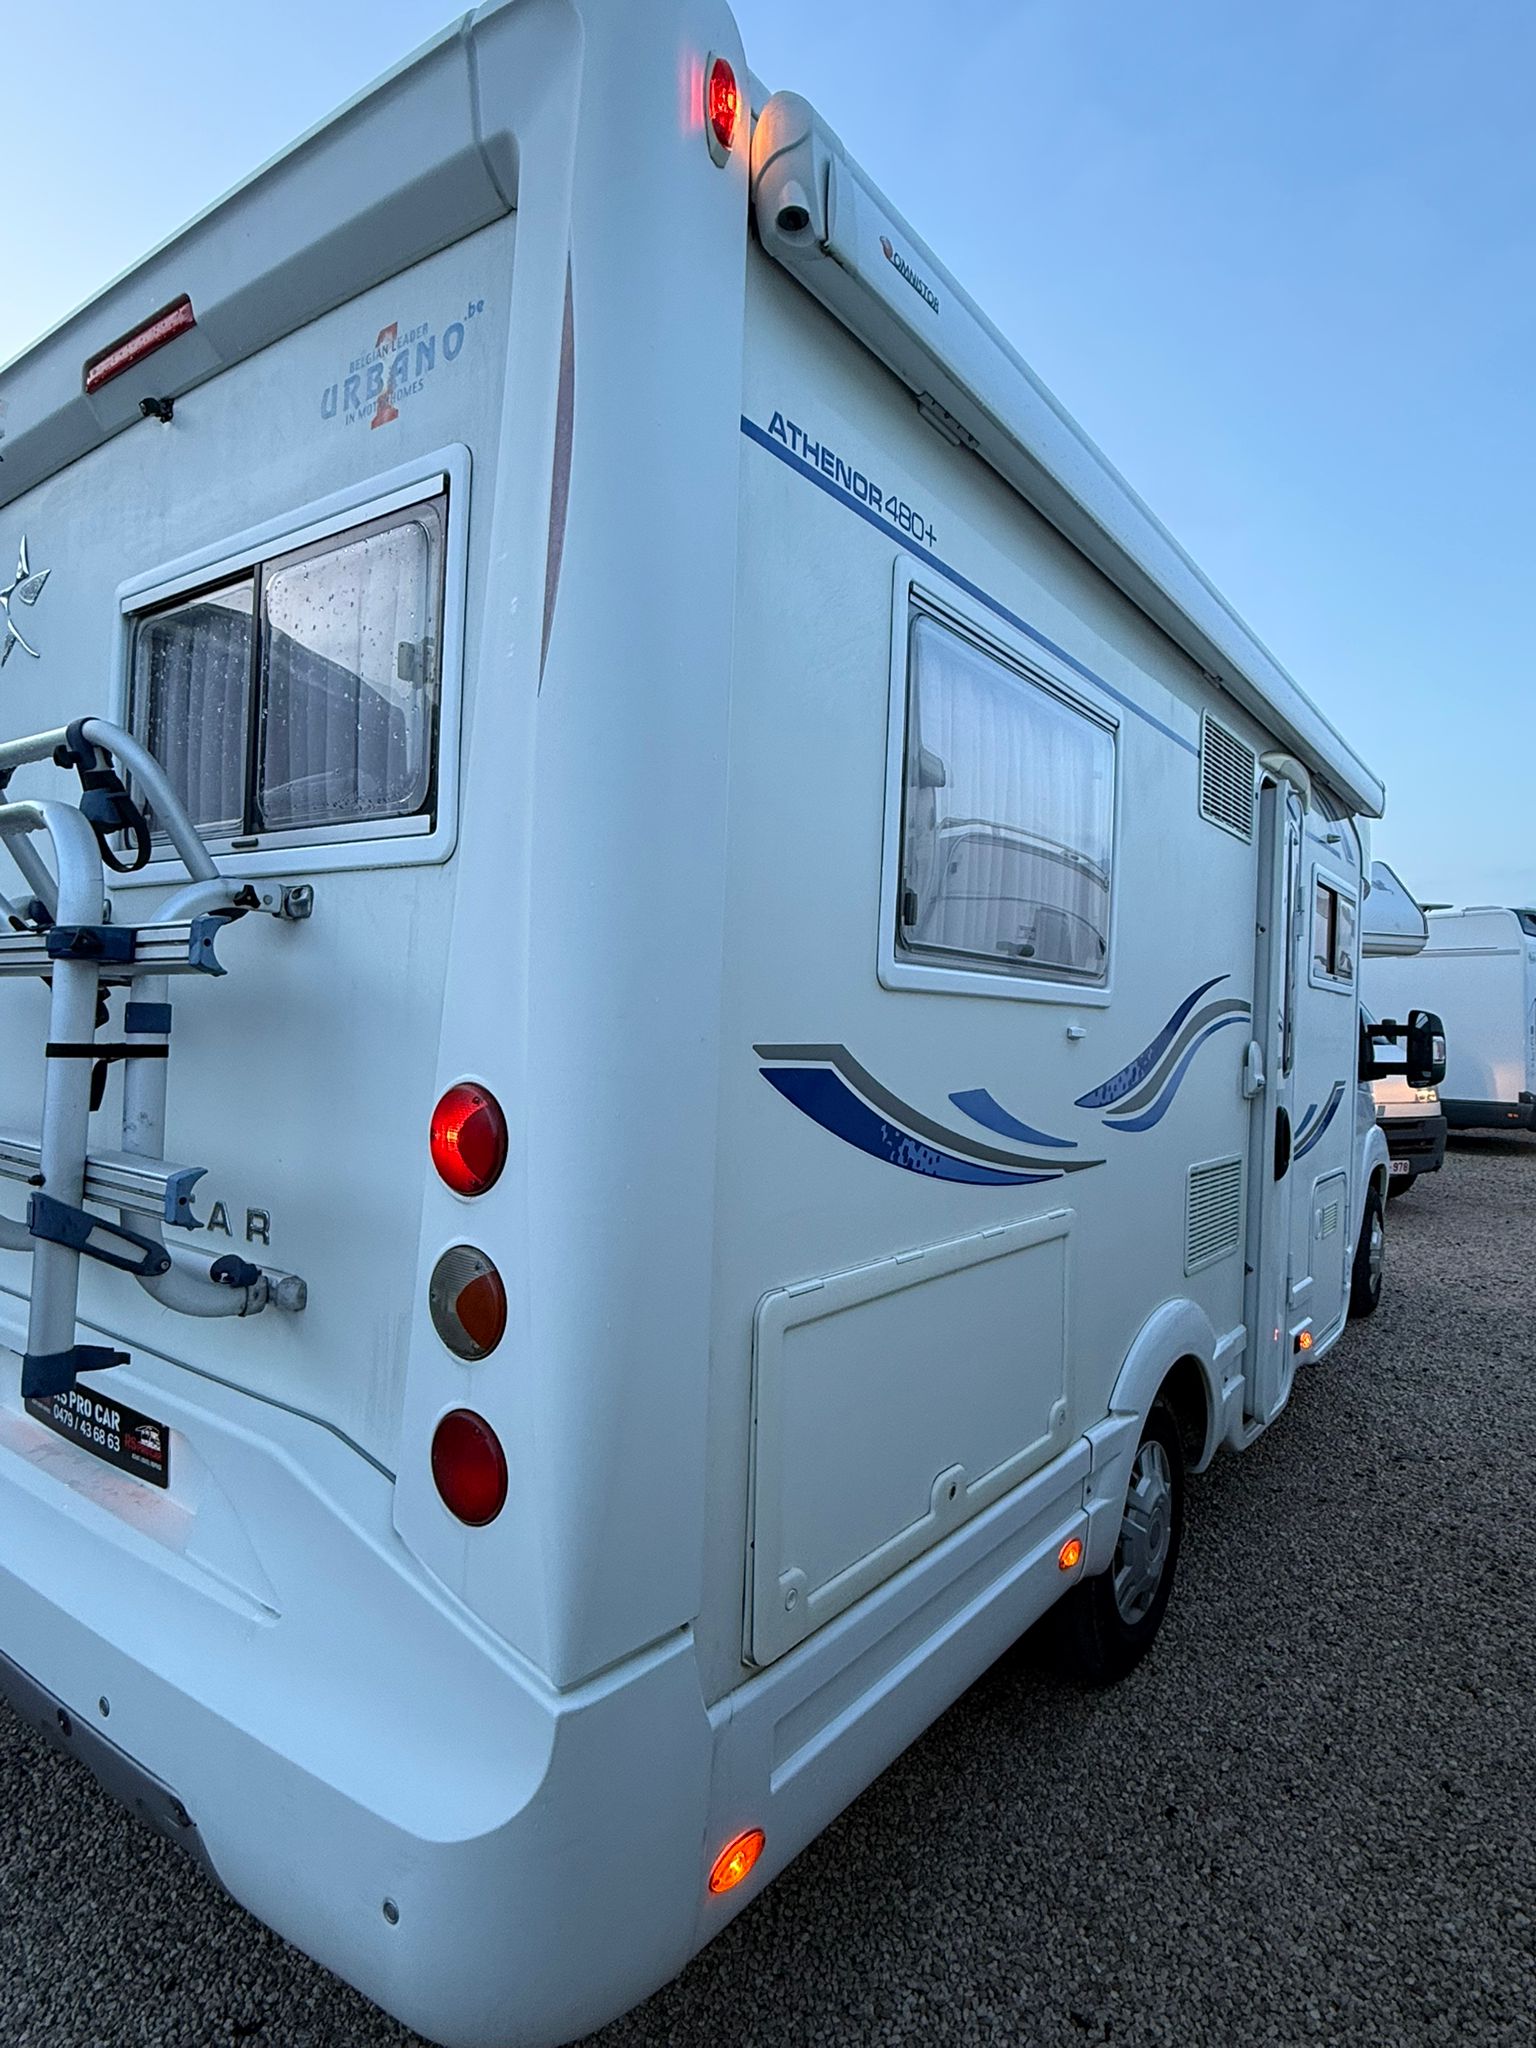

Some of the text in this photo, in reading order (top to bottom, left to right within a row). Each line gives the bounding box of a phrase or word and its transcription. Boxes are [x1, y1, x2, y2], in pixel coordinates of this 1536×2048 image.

[893, 252, 940, 315] OMNISTOR
[349, 321, 429, 374] BELGIAN LEADER
[345, 413, 355, 426] IN
[767, 411, 883, 513] ATHENOR
[53, 1404, 74, 1428] 0479
[80, 1420, 92, 1438] 43
[93, 1425, 106, 1446] 68
[107, 1432, 121, 1452] 63
[69, 1390, 92, 1418] PRO
[95, 1403, 121, 1433] CAR
